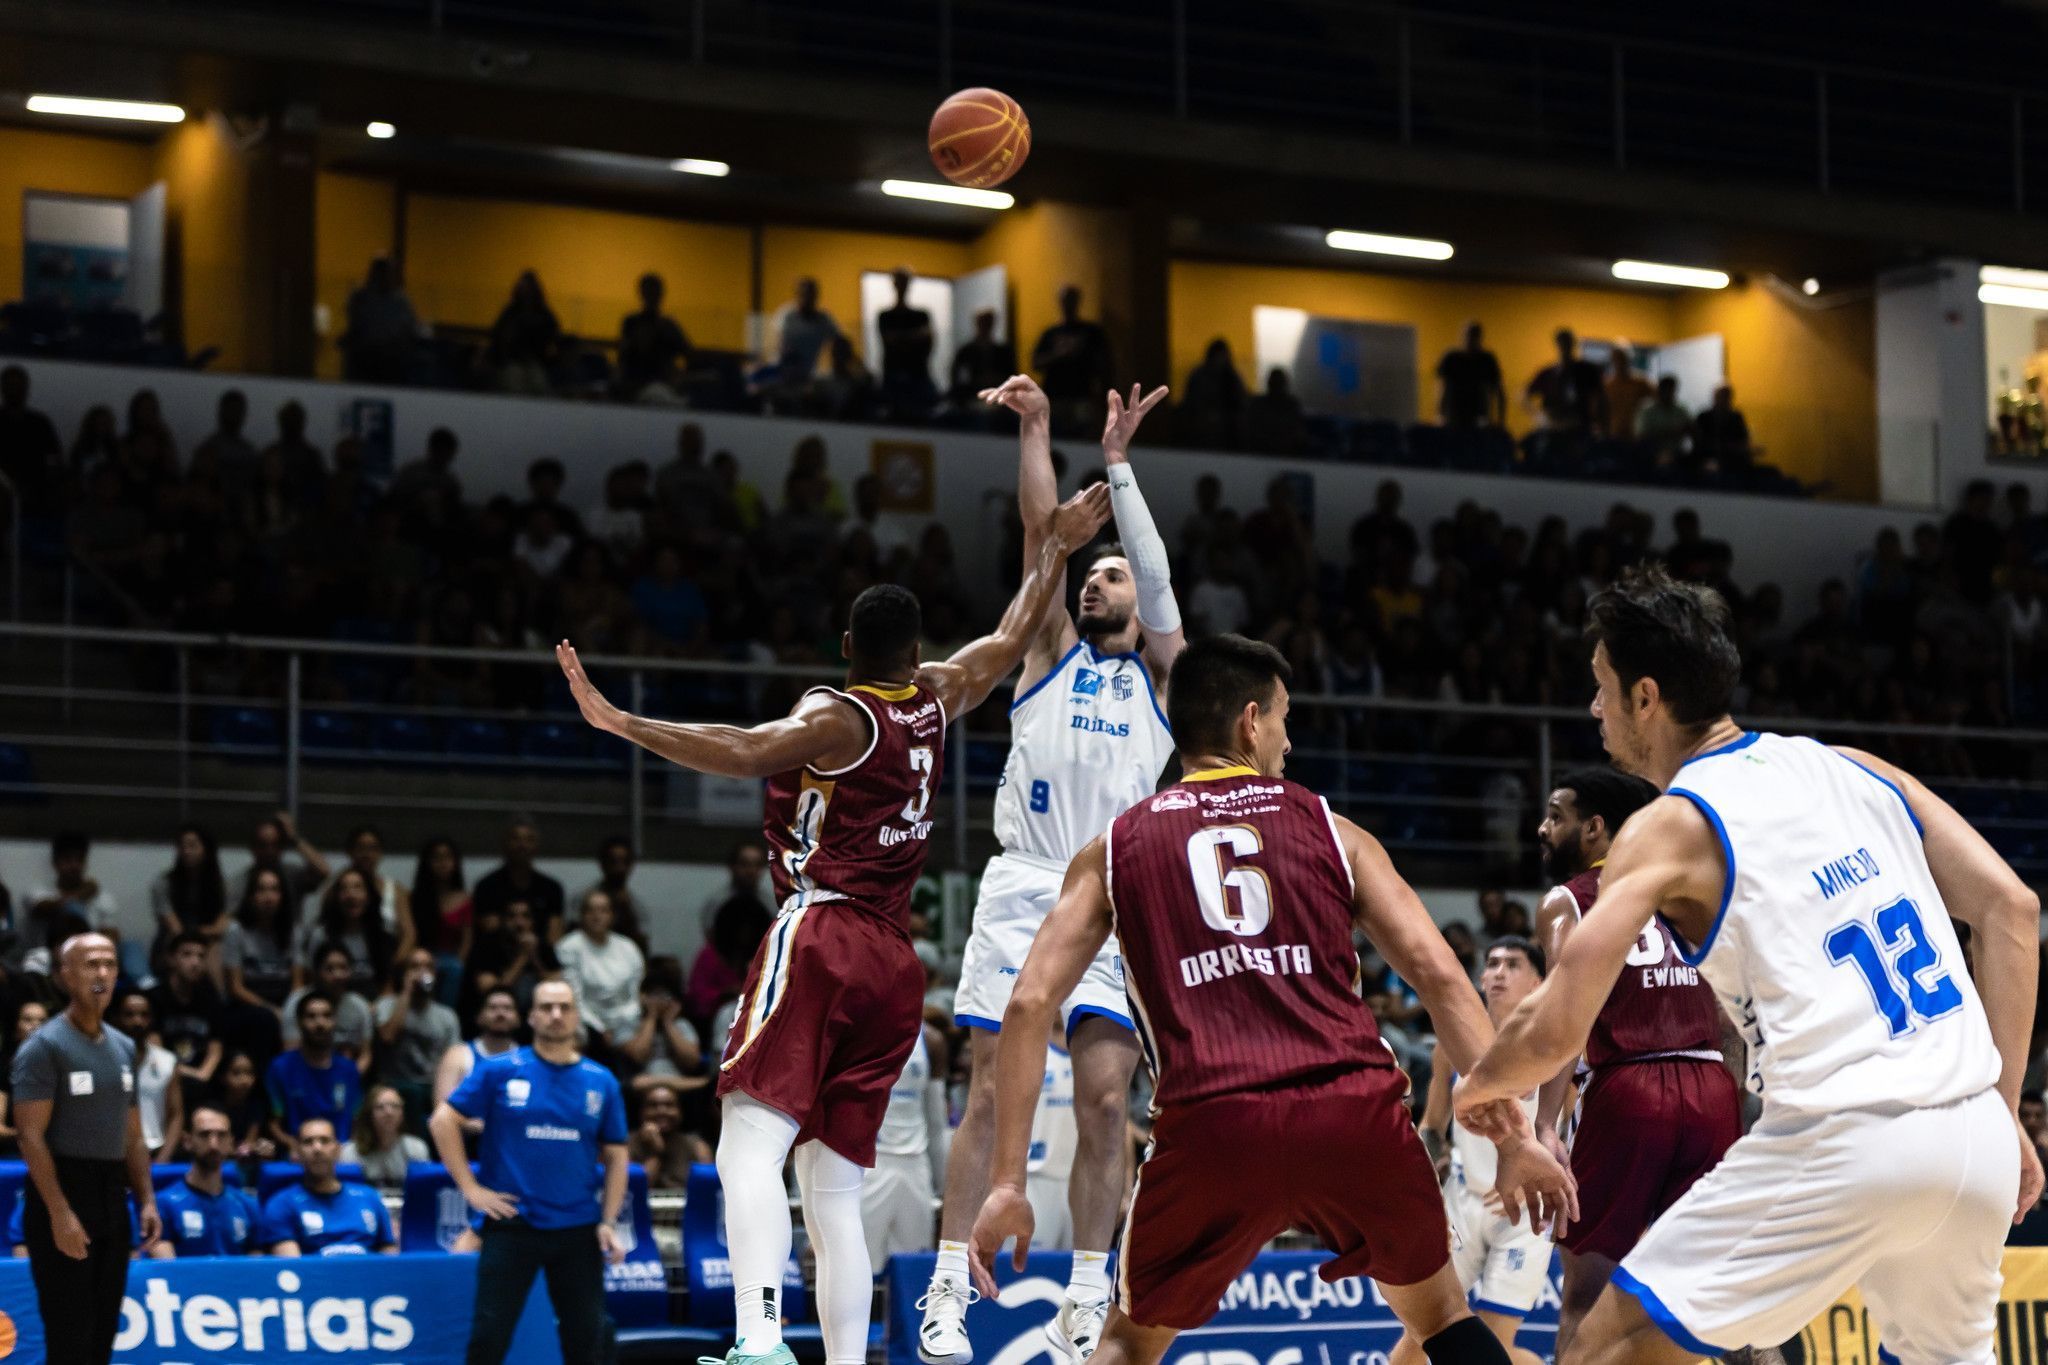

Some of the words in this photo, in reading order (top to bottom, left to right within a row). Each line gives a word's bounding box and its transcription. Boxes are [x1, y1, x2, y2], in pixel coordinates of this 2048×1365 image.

[1071, 714, 1130, 737] minas
[900, 746, 934, 824] 3
[1030, 779, 1050, 814] 9
[1200, 784, 1284, 803] Fortaleza
[1187, 823, 1274, 936] 6
[1179, 943, 1313, 988] ORRESTA
[1642, 966, 1699, 989] EWING
[1823, 892, 1965, 1040] 12
[111, 1269, 416, 1353] oterias
[1218, 1263, 1365, 1320] MAÇÃO
